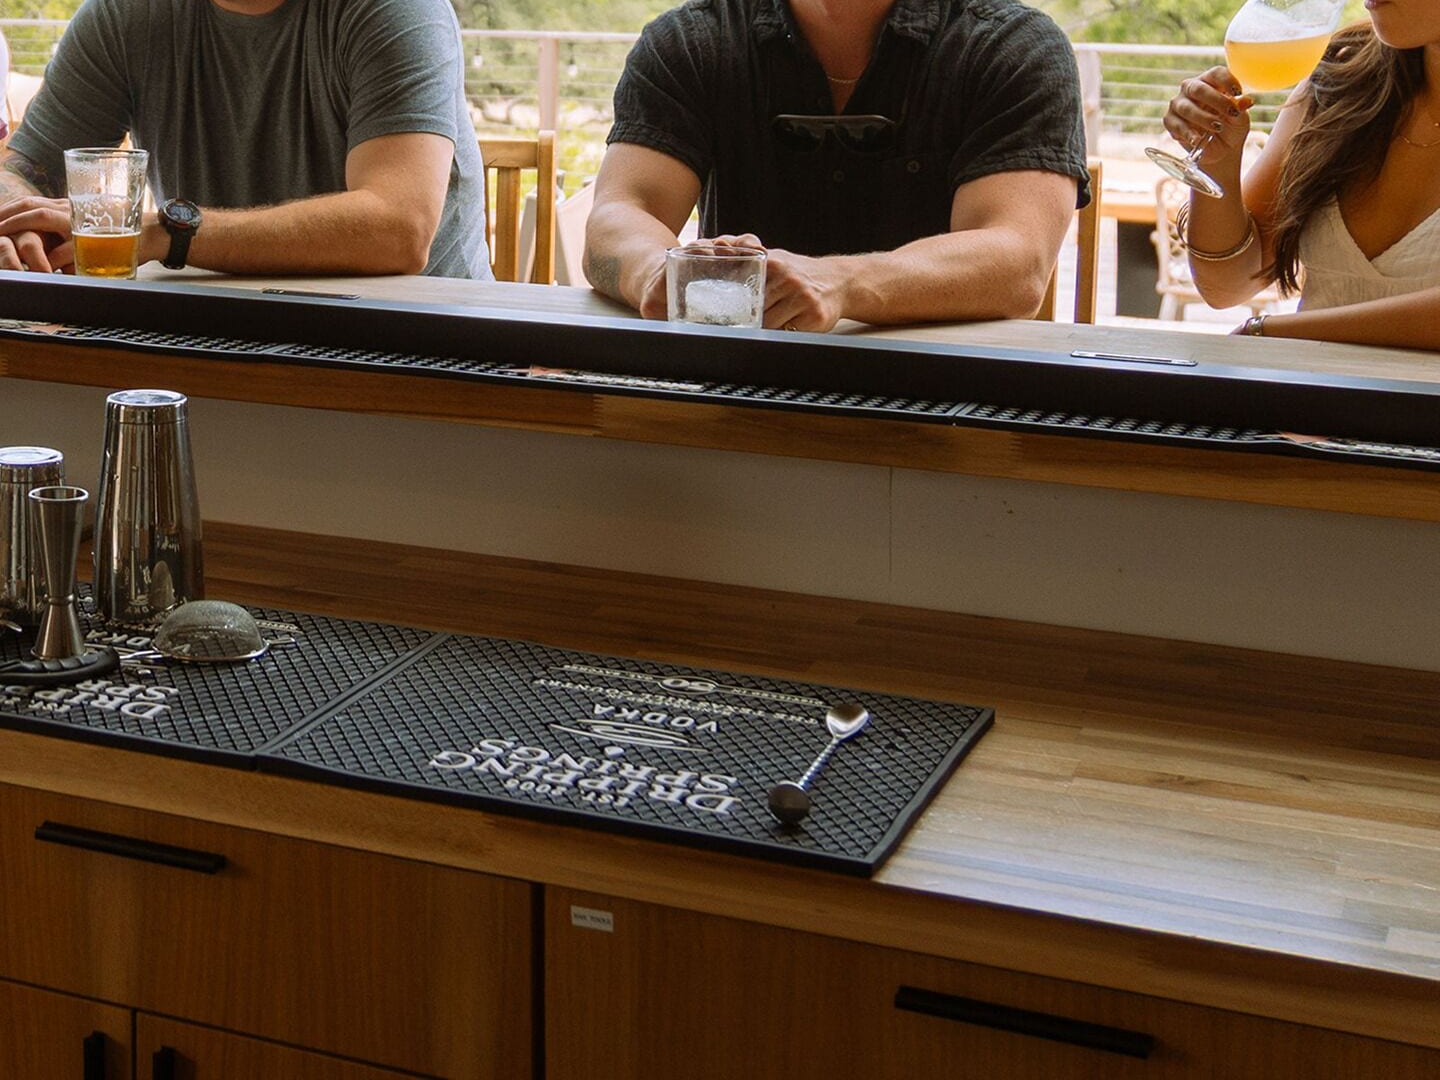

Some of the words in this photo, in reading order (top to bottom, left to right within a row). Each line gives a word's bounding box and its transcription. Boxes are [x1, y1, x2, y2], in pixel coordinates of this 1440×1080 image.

[662, 678, 717, 692] 50
[594, 703, 720, 733] VODKA
[429, 750, 741, 815] DRIPPING
[472, 738, 738, 793] SPRINGS
